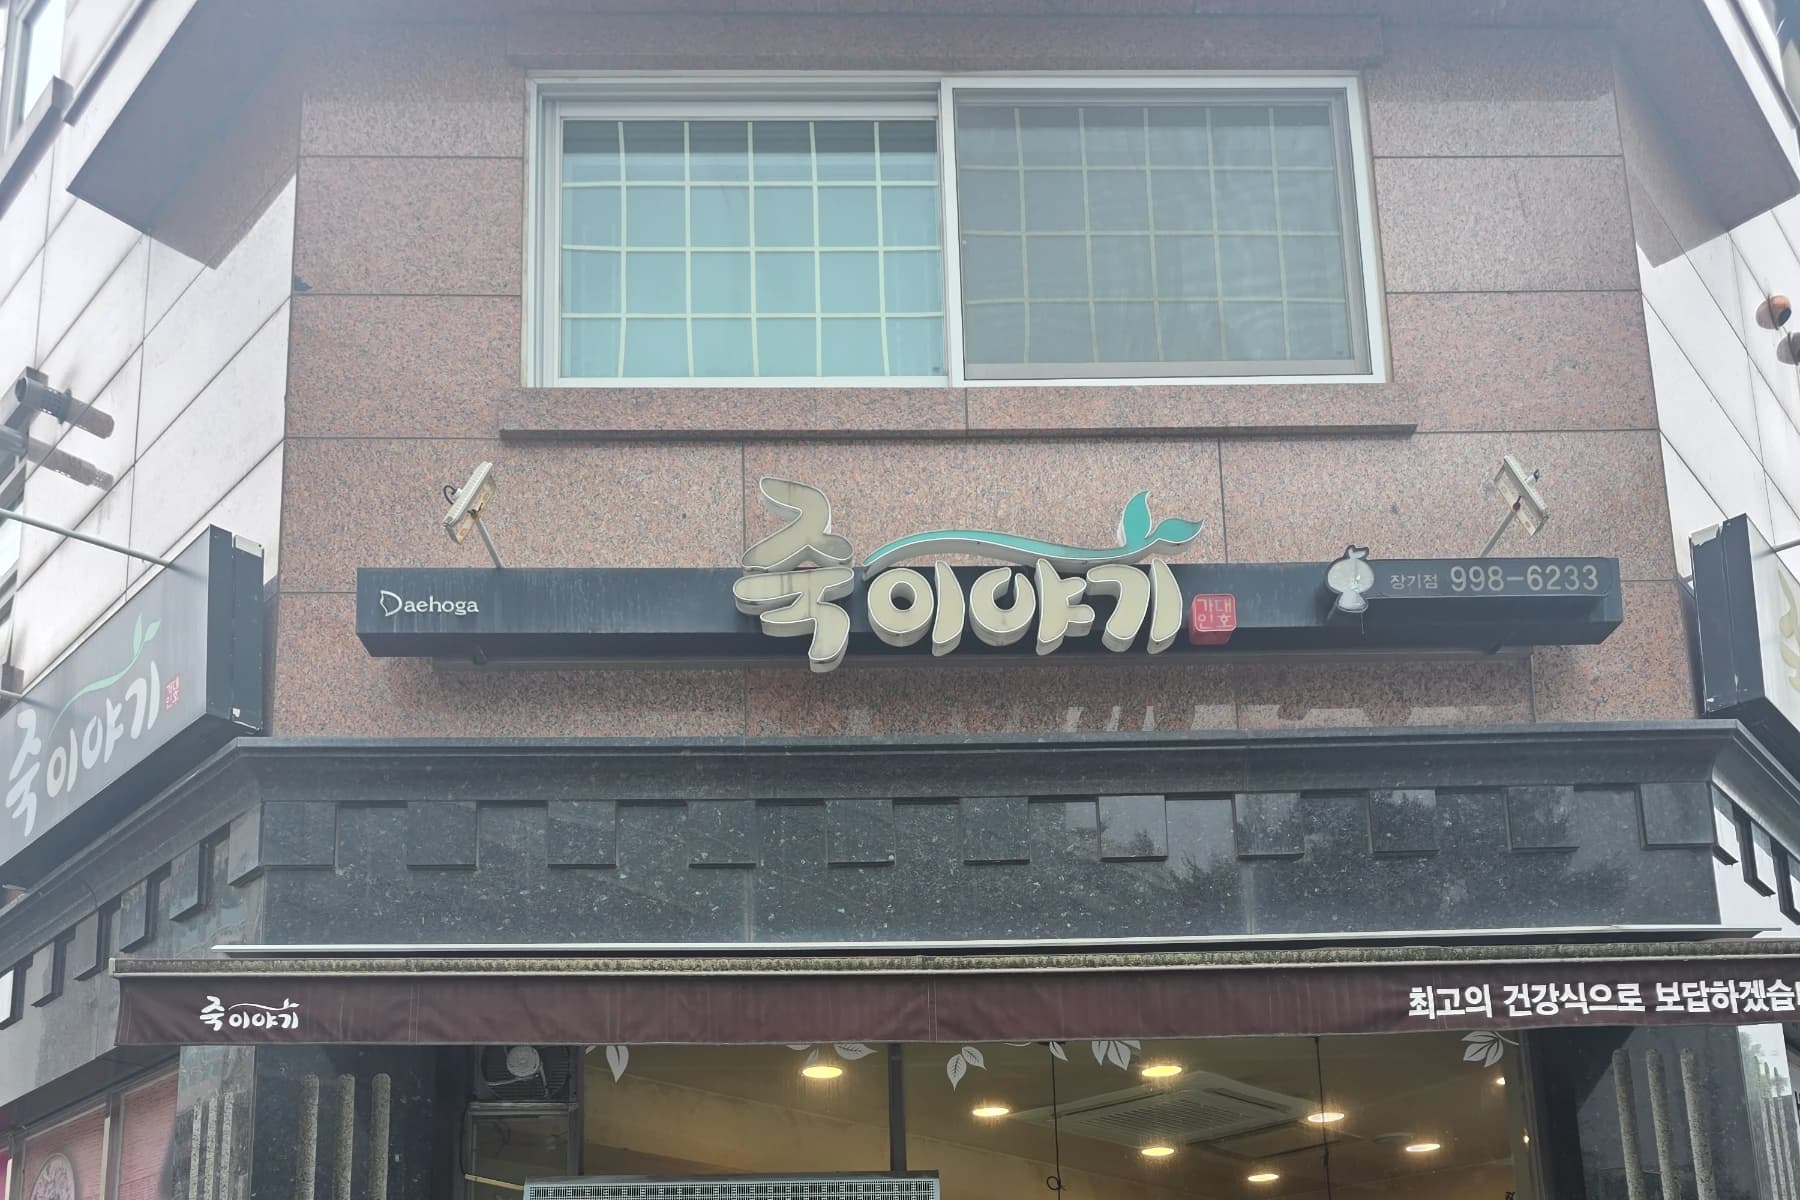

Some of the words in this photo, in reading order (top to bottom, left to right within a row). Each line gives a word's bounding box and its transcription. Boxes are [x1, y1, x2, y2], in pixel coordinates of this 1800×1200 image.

[733, 476, 1184, 671] 죽이야기
[1390, 573, 1438, 590] 장기점
[1450, 564, 1599, 592] 998-6233
[380, 590, 479, 617] Daehoga
[6, 660, 160, 837] 죽이야기
[199, 995, 299, 1032] 죽이야기
[1408, 983, 1493, 1020] 최고의
[1503, 982, 1646, 1018] 건강식으로
[1655, 978, 1800, 1014] 보답하겠습
